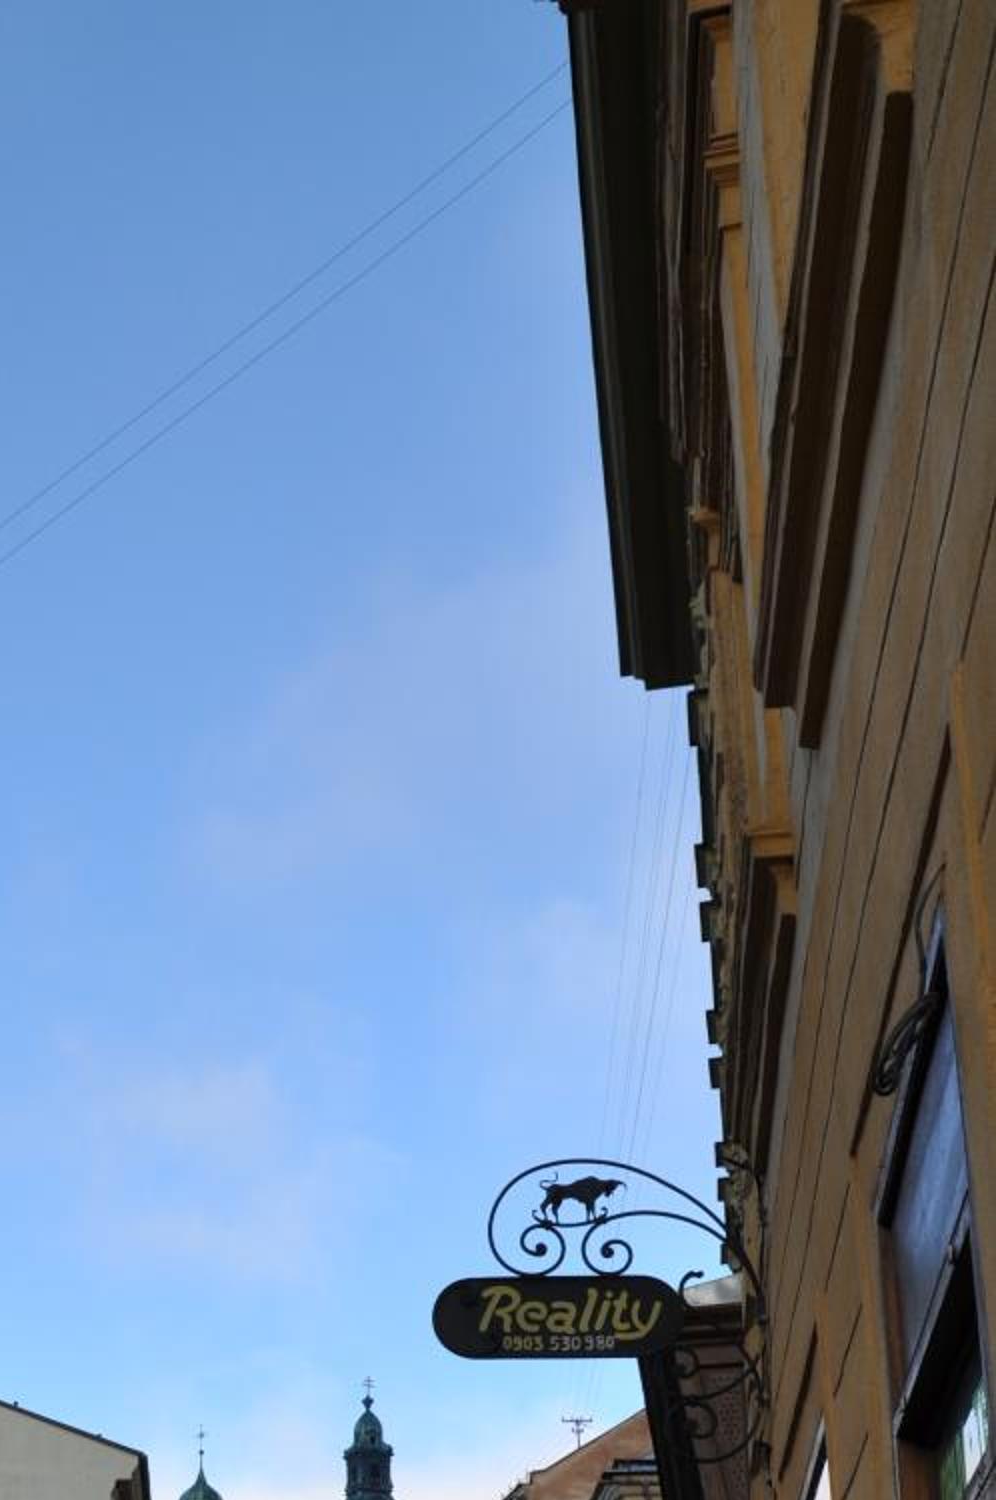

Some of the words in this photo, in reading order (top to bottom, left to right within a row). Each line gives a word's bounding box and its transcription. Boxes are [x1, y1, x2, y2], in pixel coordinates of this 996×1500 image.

[479, 1284, 663, 1341] Reality
[502, 1335, 545, 1351] 0903
[549, 1335, 581, 1351] 530
